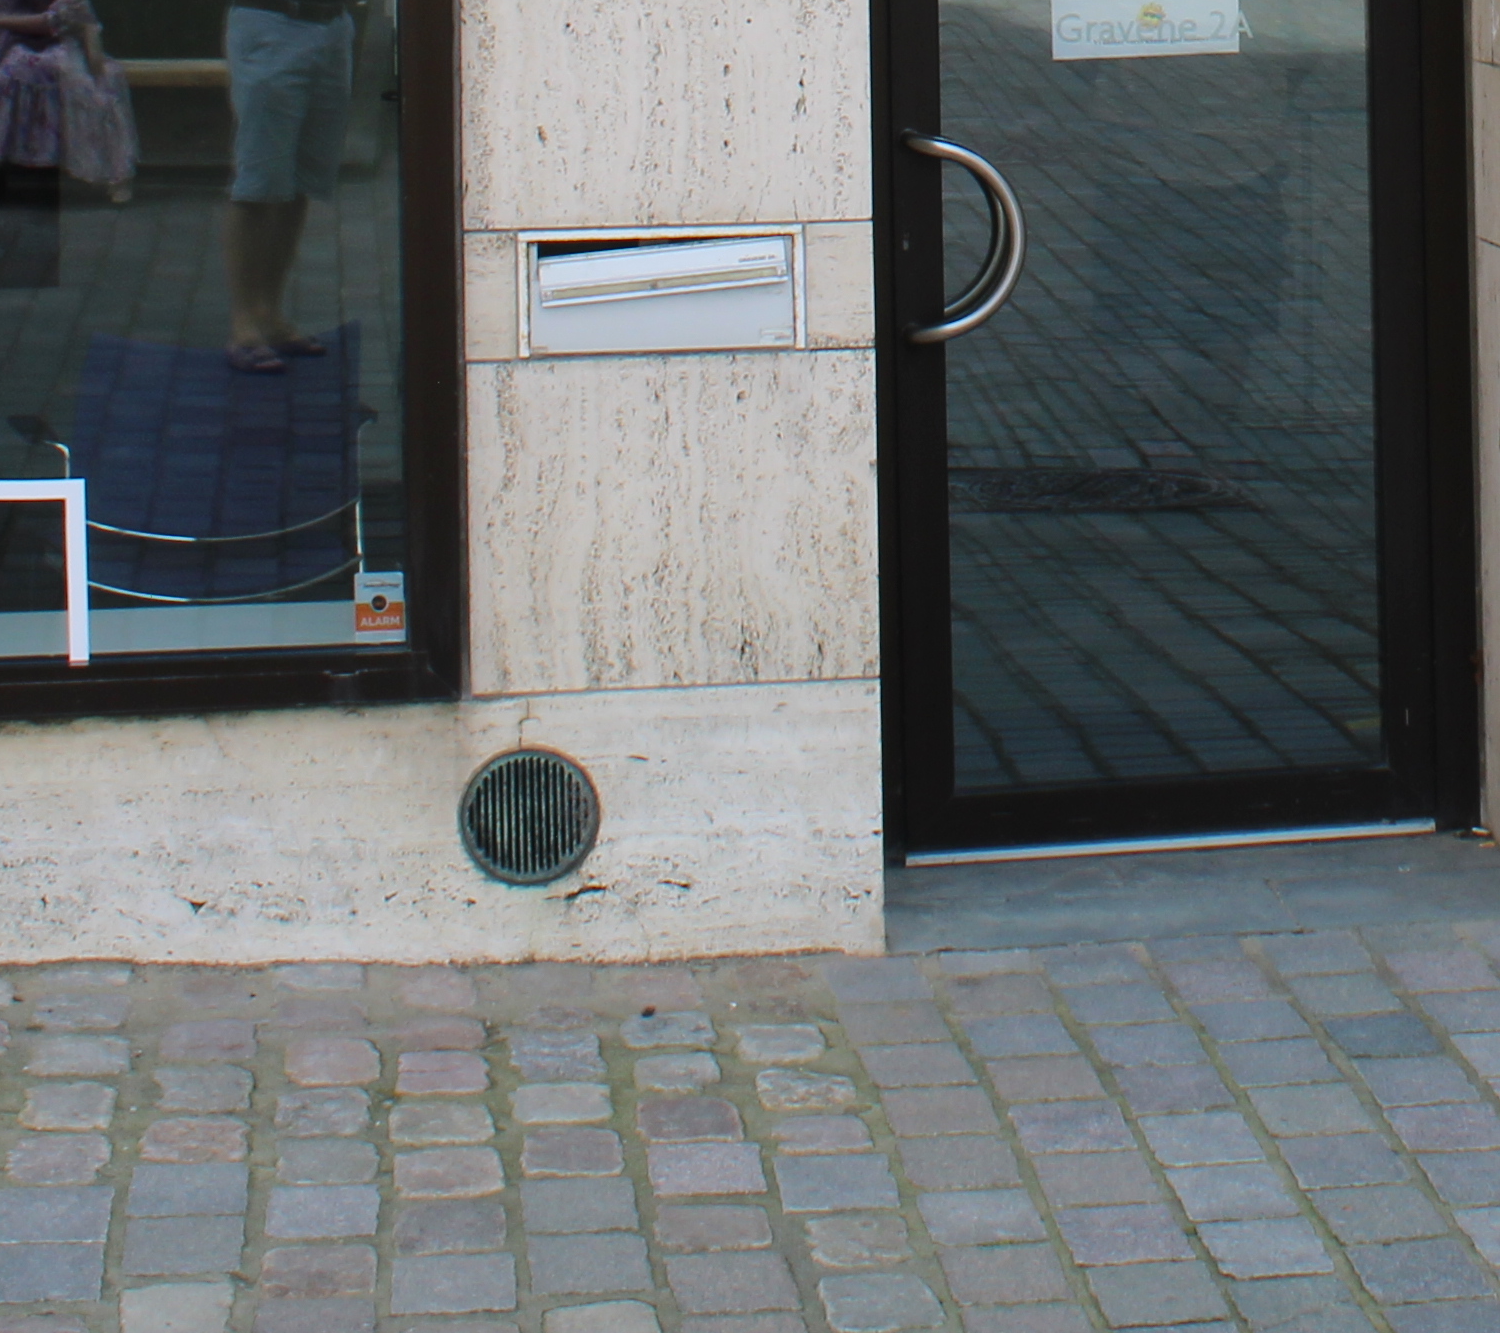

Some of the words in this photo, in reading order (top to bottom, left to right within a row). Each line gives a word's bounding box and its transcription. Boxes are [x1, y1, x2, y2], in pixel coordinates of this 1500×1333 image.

[1056, 12, 1198, 44] Gravene
[1210, 9, 1255, 41] 2A
[360, 615, 401, 627] ALARM
